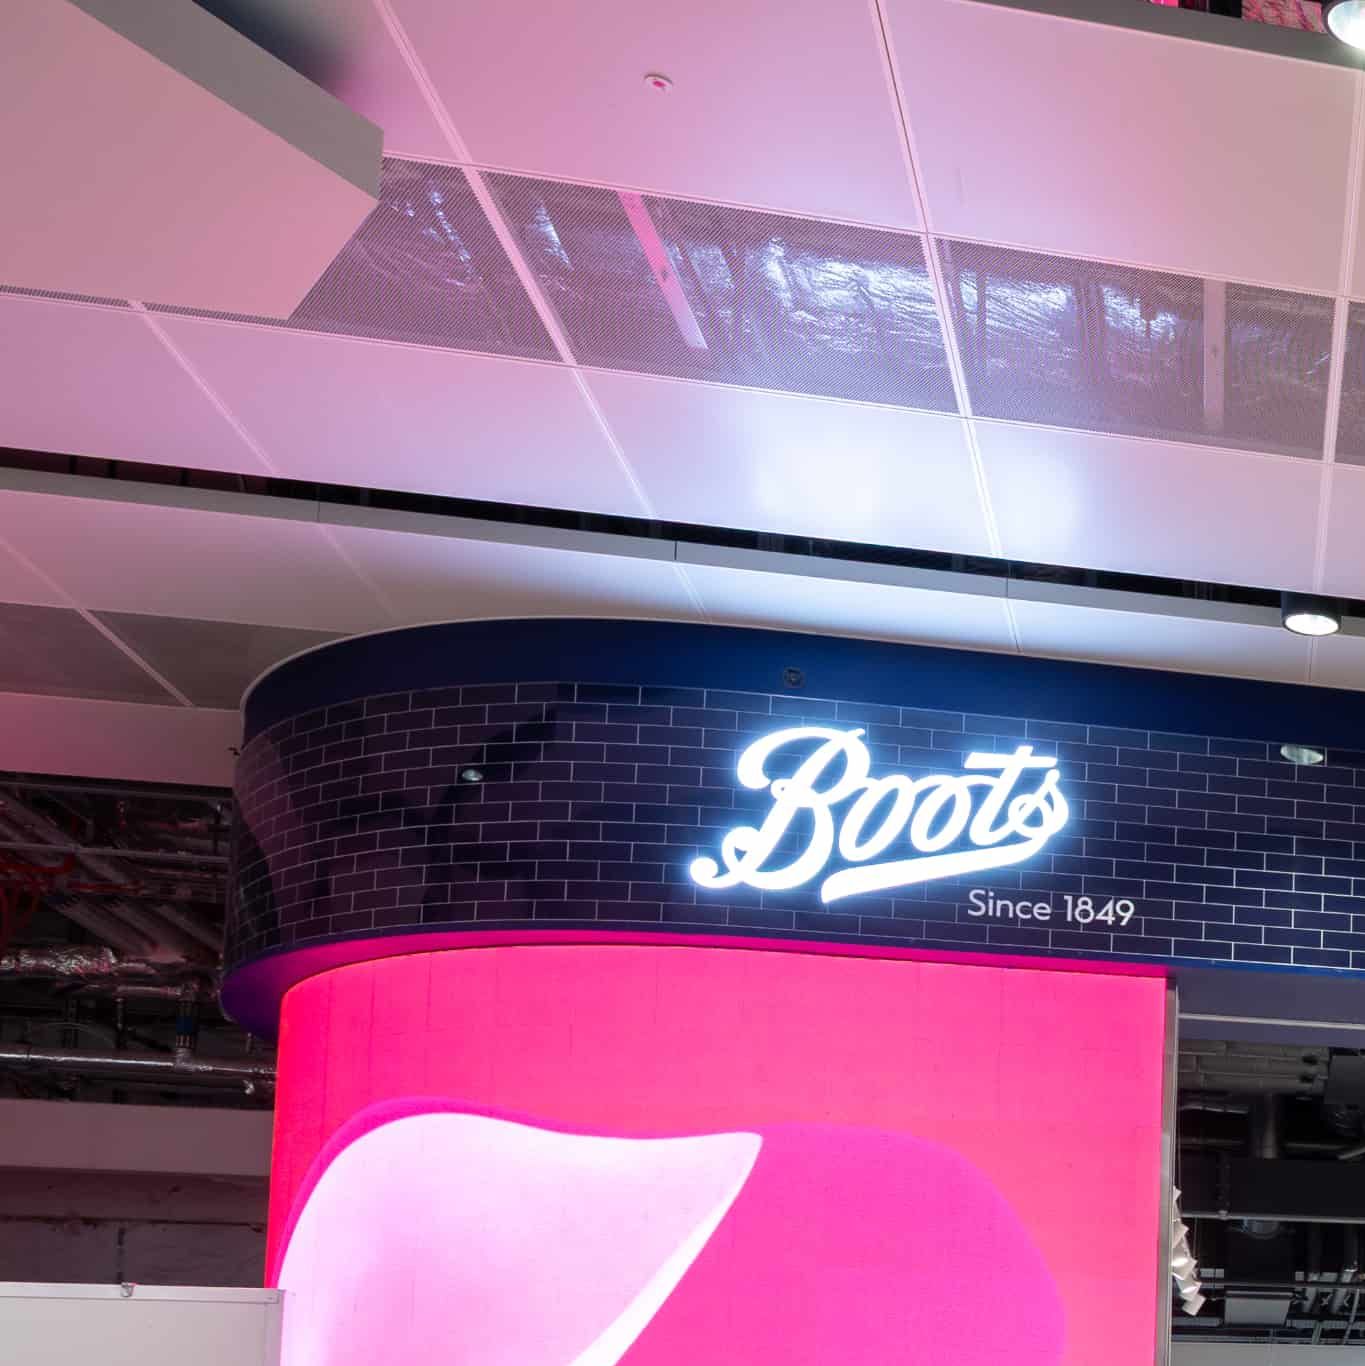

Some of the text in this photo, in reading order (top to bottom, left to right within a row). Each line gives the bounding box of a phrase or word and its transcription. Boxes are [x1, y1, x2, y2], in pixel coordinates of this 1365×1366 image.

[690, 726, 1069, 903] Boots
[967, 889, 1135, 927] Since 1849
